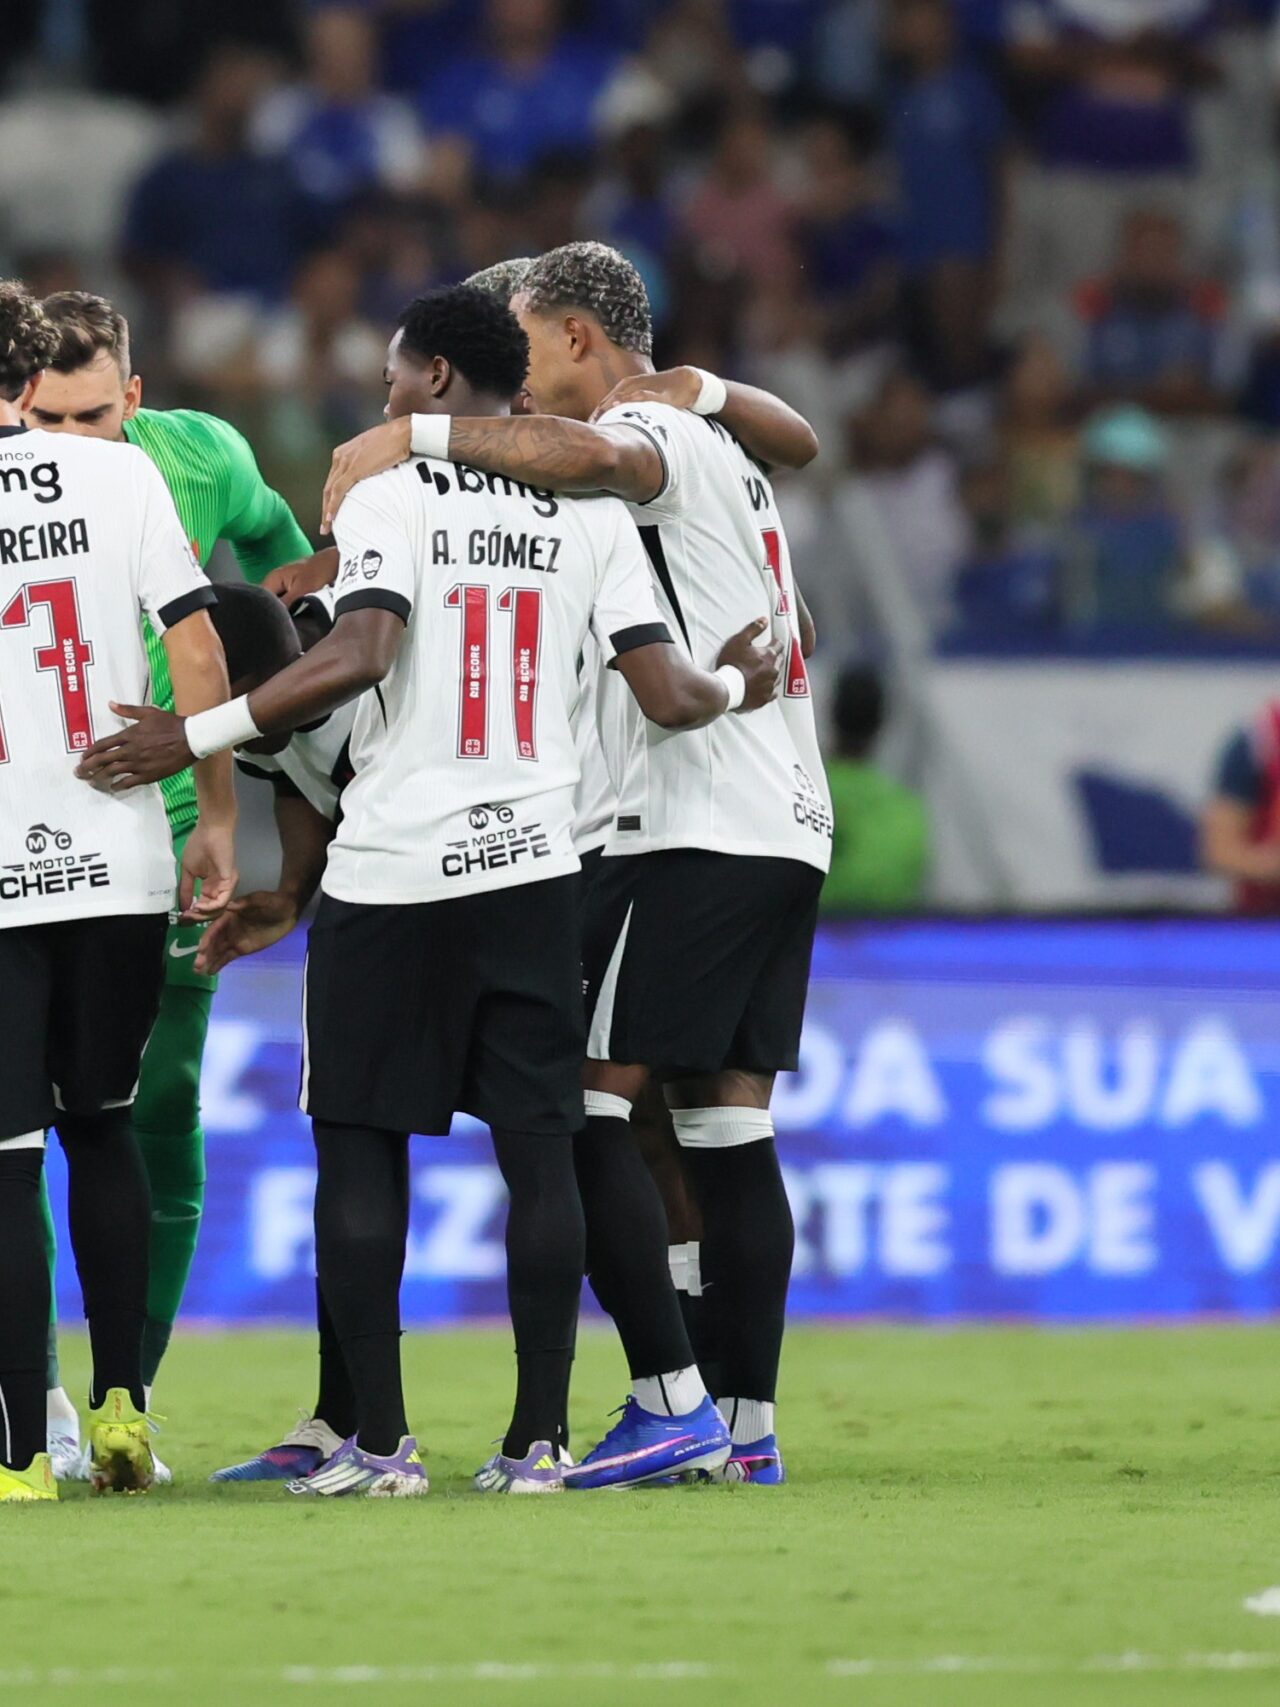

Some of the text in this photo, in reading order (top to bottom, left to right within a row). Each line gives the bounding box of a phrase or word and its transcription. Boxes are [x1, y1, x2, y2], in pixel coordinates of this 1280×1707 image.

[432, 525, 562, 574] A. GÓMEZ
[63, 638, 76, 673] SCORE
[443, 583, 543, 762] 11
[470, 644, 481, 679] SCORE
[520, 648, 531, 683] SCORE
[442, 833, 551, 877] CHEFE
[472, 828, 517, 847] MOTO
[28, 856, 76, 871] MOTO
[981, 1017, 1266, 1133] SUA
[249, 1164, 508, 1279] FZ
[988, 1162, 1160, 1278] DE
